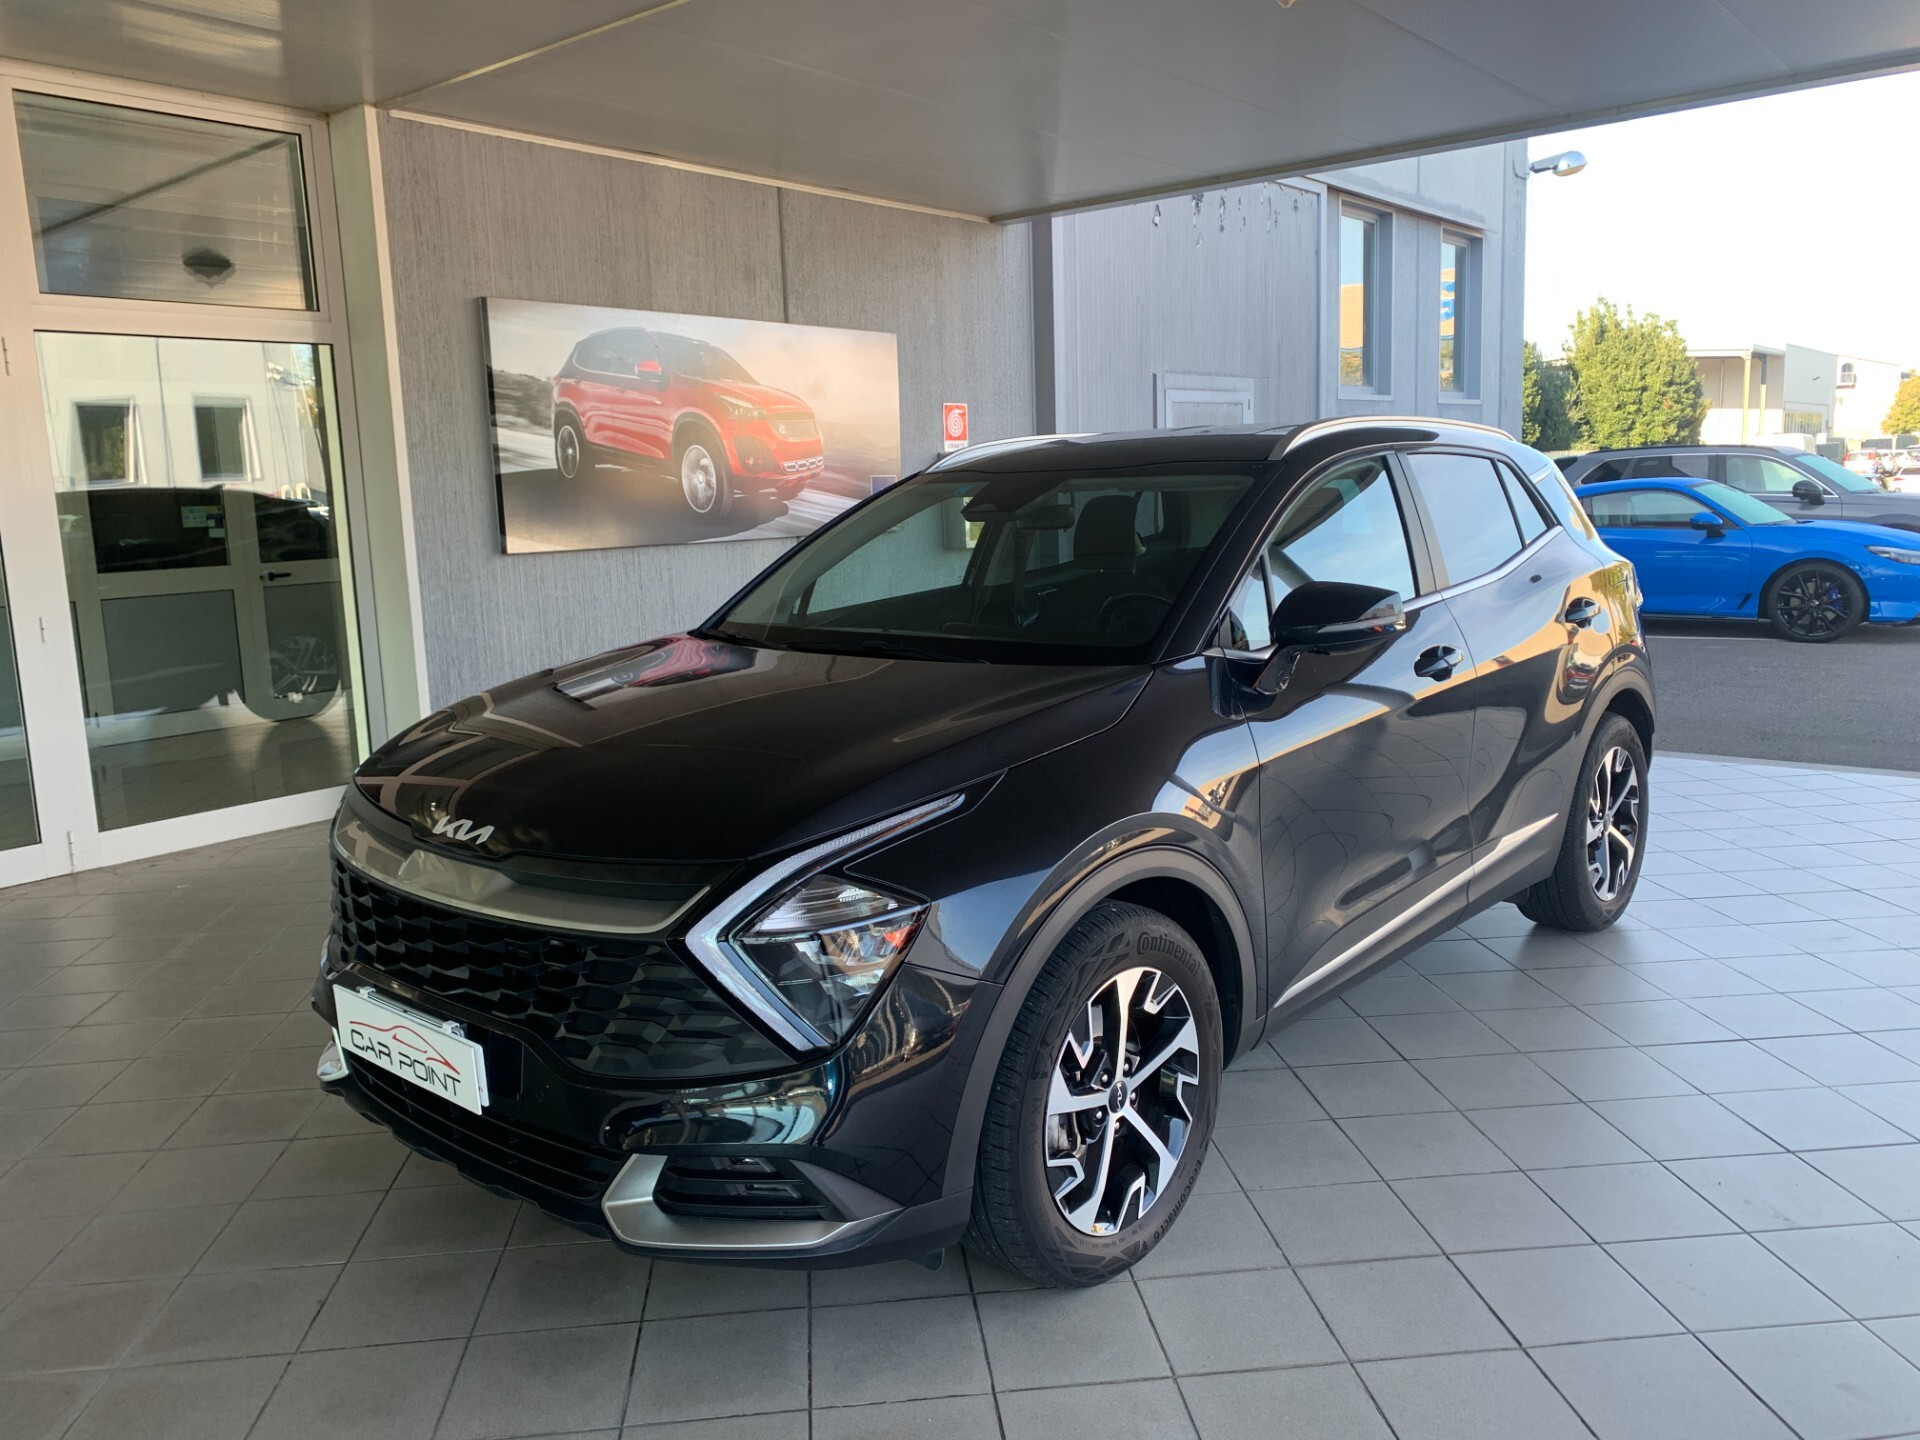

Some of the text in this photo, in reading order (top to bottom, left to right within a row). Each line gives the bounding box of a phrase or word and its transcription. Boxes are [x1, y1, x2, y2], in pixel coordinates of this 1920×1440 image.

[432, 815, 495, 845] KIA
[1137, 931, 1200, 977] Continental
[351, 1029, 461, 1096] CAR POINT
